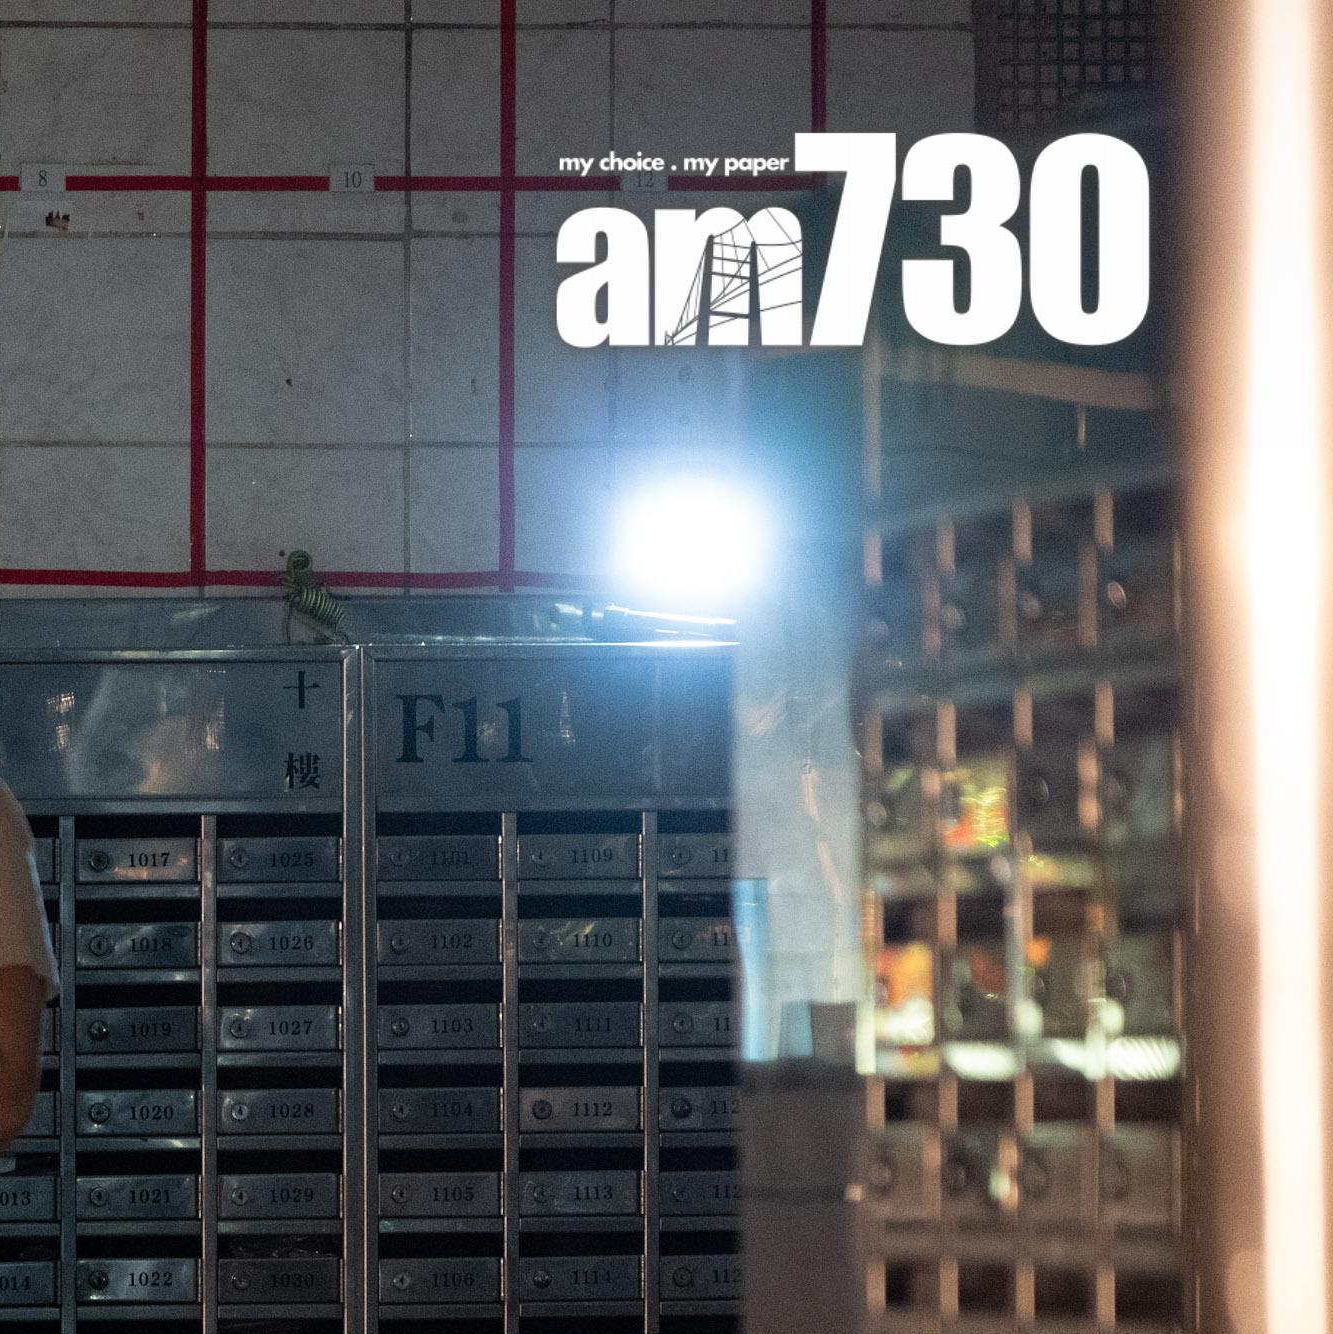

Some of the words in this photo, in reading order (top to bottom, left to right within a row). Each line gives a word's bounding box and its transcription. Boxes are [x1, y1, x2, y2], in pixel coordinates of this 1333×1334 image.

[38, 170, 48, 187] 8
[343, 171, 363, 188] 10
[635, 171, 655, 188] 12
[282, 670, 321, 790] 十樓
[395, 693, 533, 764] F11
[128, 851, 171, 869] 1017
[270, 851, 317, 869] 1025
[571, 847, 615, 865] 1109
[269, 934, 315, 952] 1026
[431, 933, 473, 951] 1102
[572, 932, 613, 948] 1110
[269, 1019, 314, 1037] 1027
[431, 1017, 474, 1035] 1103
[130, 1105, 174, 1121] 1020
[269, 1103, 315, 1119] 1028
[573, 1101, 613, 1118] 1112
[710, 1098, 740, 1117] 112
[129, 1188, 170, 1205] 1021
[270, 1187, 315, 1205] 1029
[432, 1185, 475, 1203] 1105
[571, 1184, 614, 1203] 1113
[712, 1183, 743, 1200] 112
[129, 1271, 173, 1288] 1022
[432, 1271, 475, 1289] 1106
[712, 1268, 742, 1285] 112
